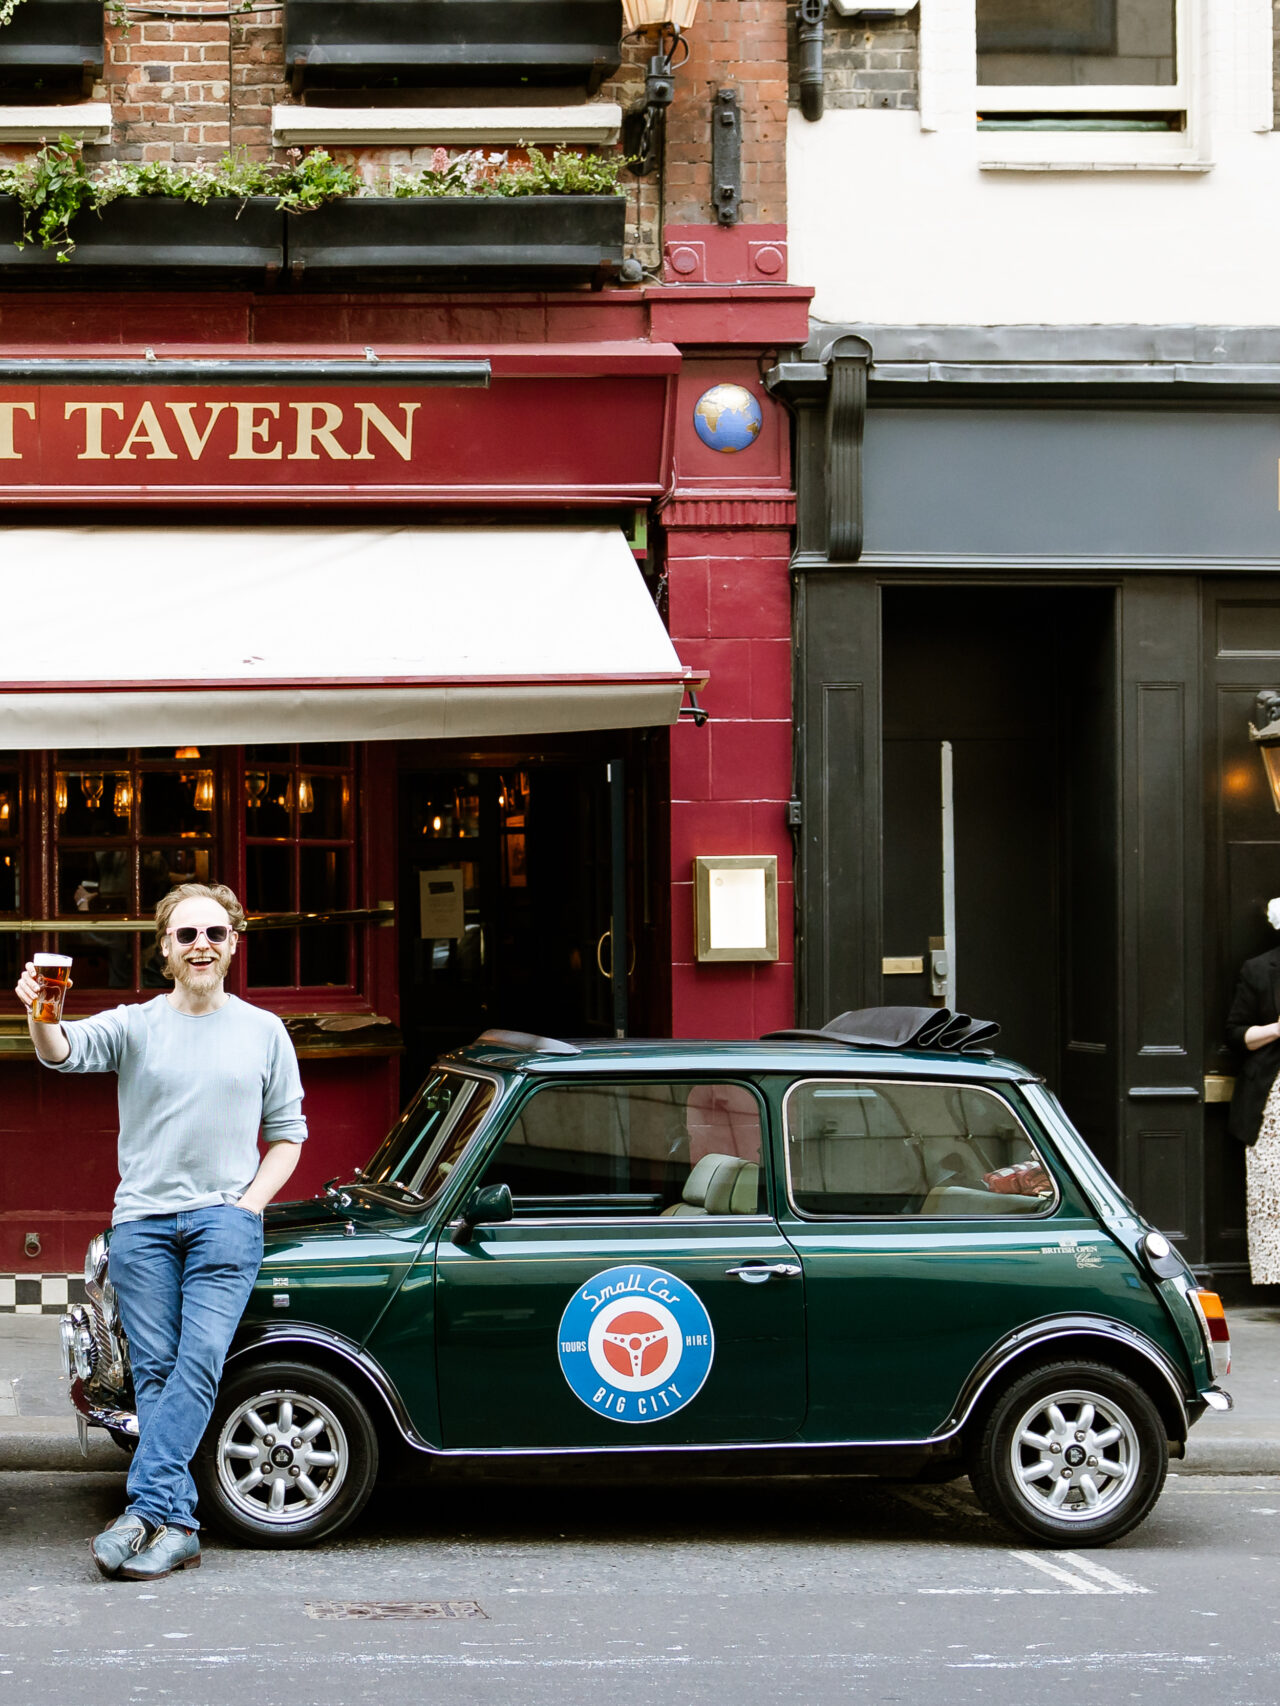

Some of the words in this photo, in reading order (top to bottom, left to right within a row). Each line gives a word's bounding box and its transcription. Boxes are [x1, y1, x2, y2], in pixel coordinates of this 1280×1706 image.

[64, 400, 421, 461] TAVERN
[1041, 1246, 1075, 1254] BRITISH
[1076, 1245, 1098, 1253] OPEN
[582, 1273, 646, 1312] Small
[647, 1277, 680, 1304] Car
[560, 1341, 587, 1353] TOURS
[685, 1334, 709, 1346] HIRE
[592, 1386, 627, 1414] BIG
[637, 1383, 683, 1415] CITY
